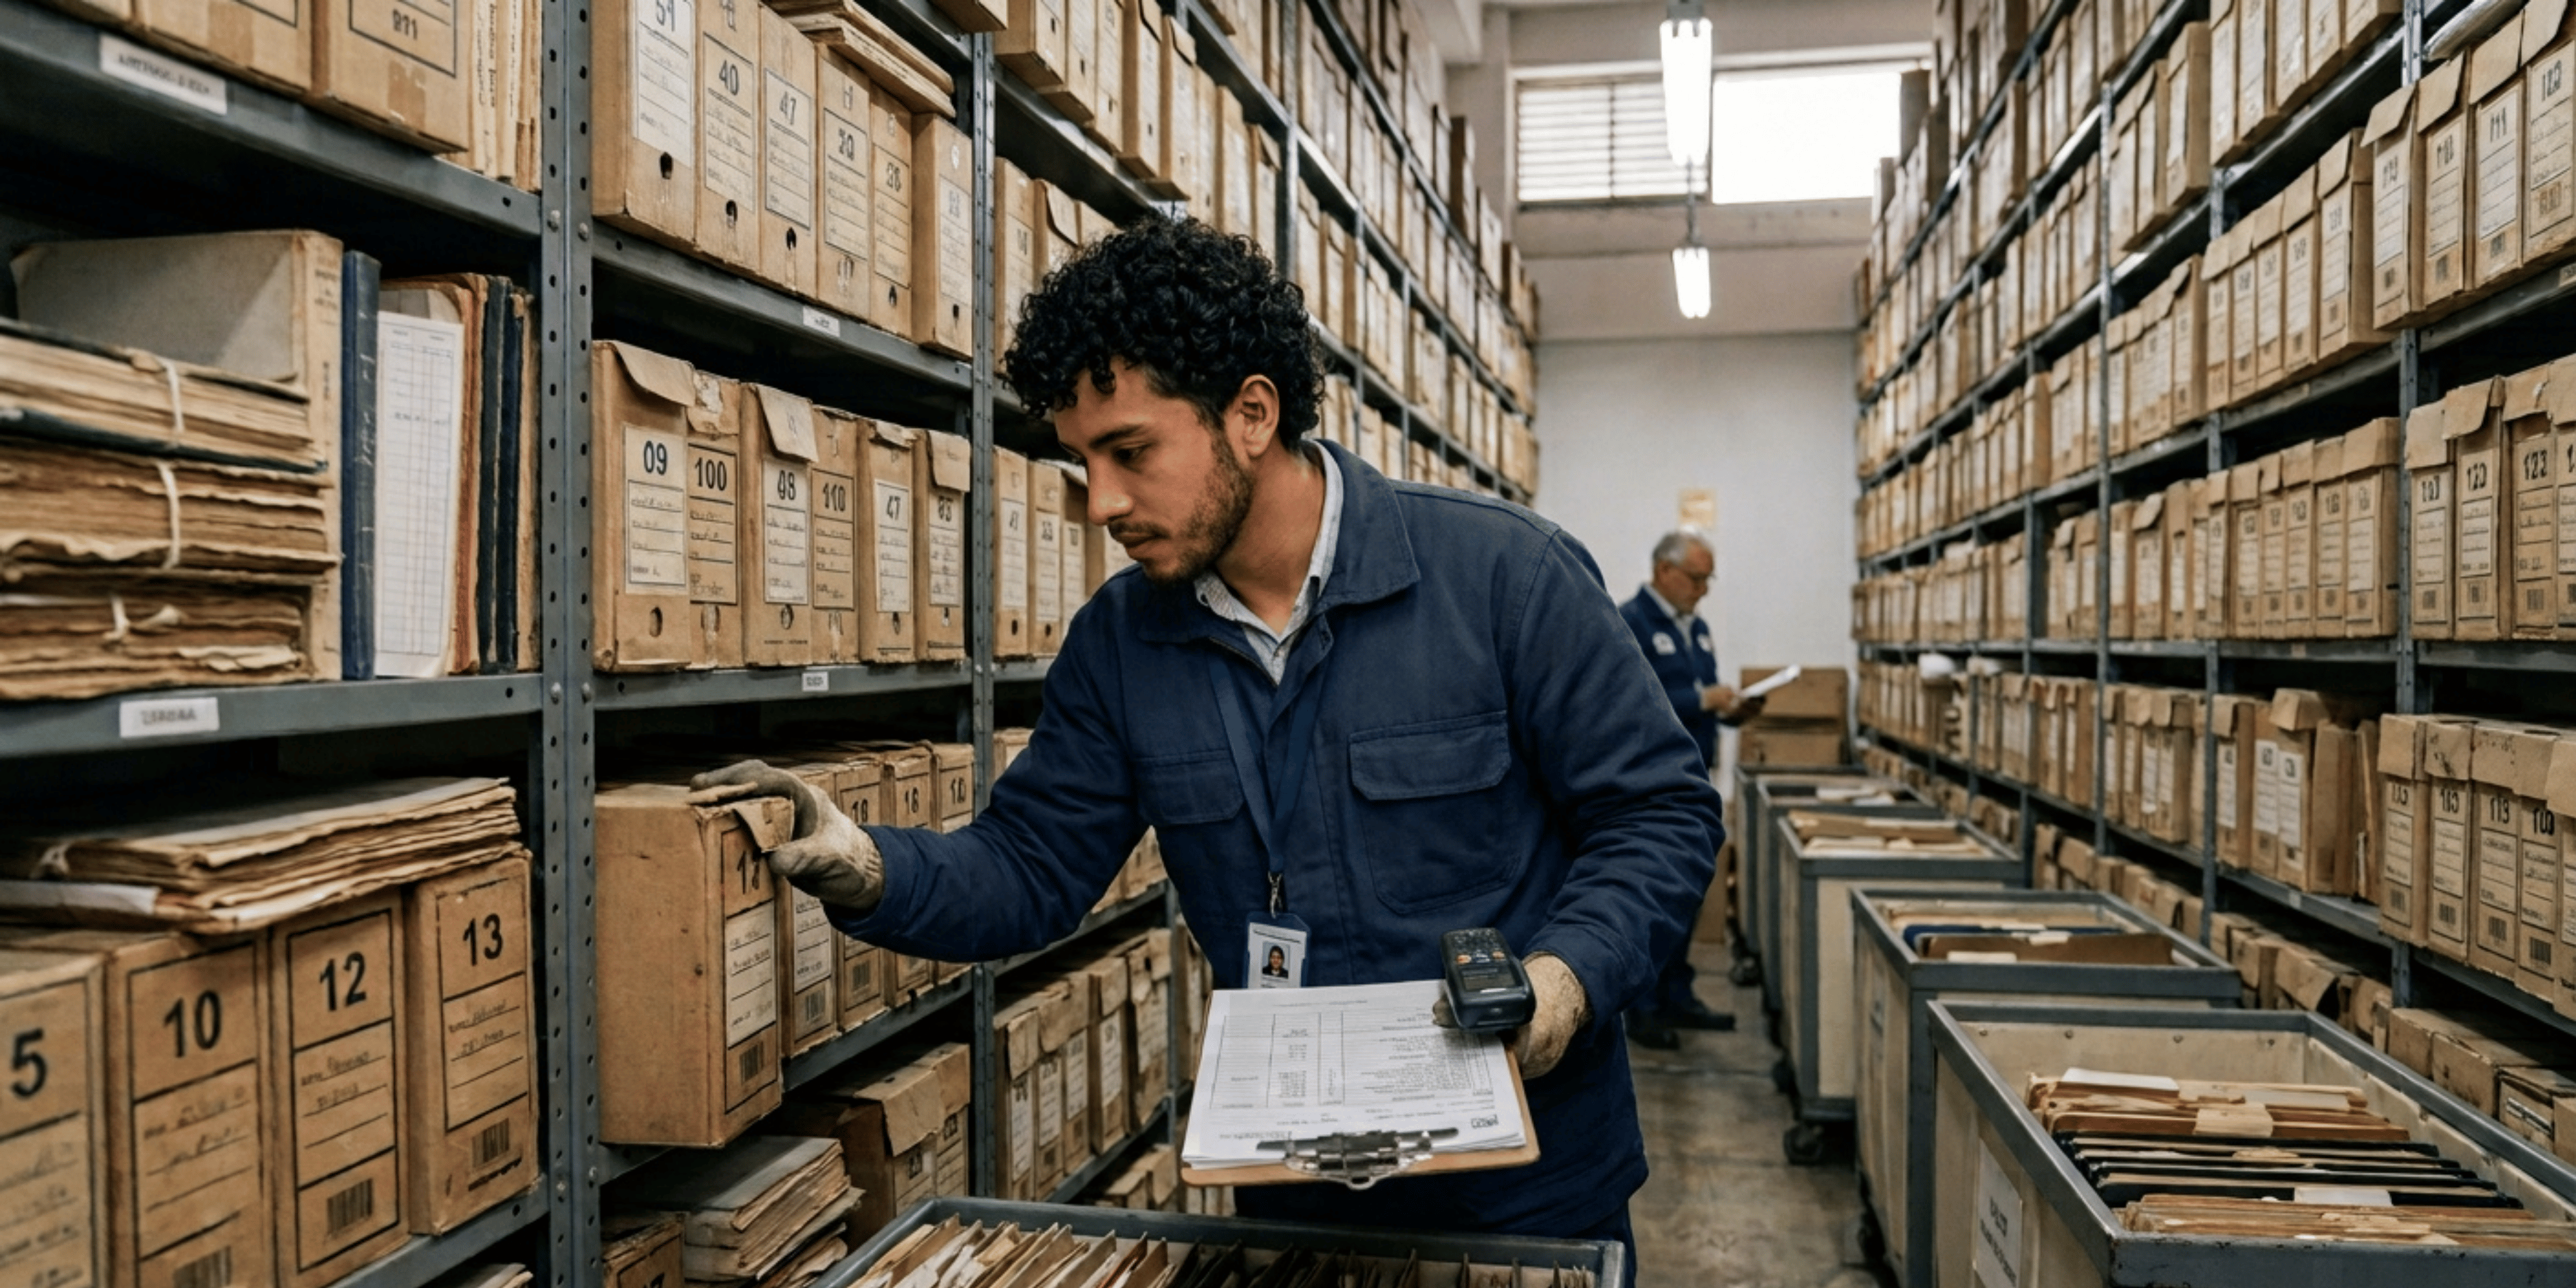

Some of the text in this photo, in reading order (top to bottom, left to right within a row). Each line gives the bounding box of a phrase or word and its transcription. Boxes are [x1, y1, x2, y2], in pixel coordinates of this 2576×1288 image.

[718, 59, 740, 96] 40
[643, 440, 667, 476] 09
[695, 457, 727, 491] 100
[462, 913, 504, 967] 13
[318, 951, 367, 1012] 12
[162, 990, 222, 1058] 10
[10, 1027, 47, 1099] 5
